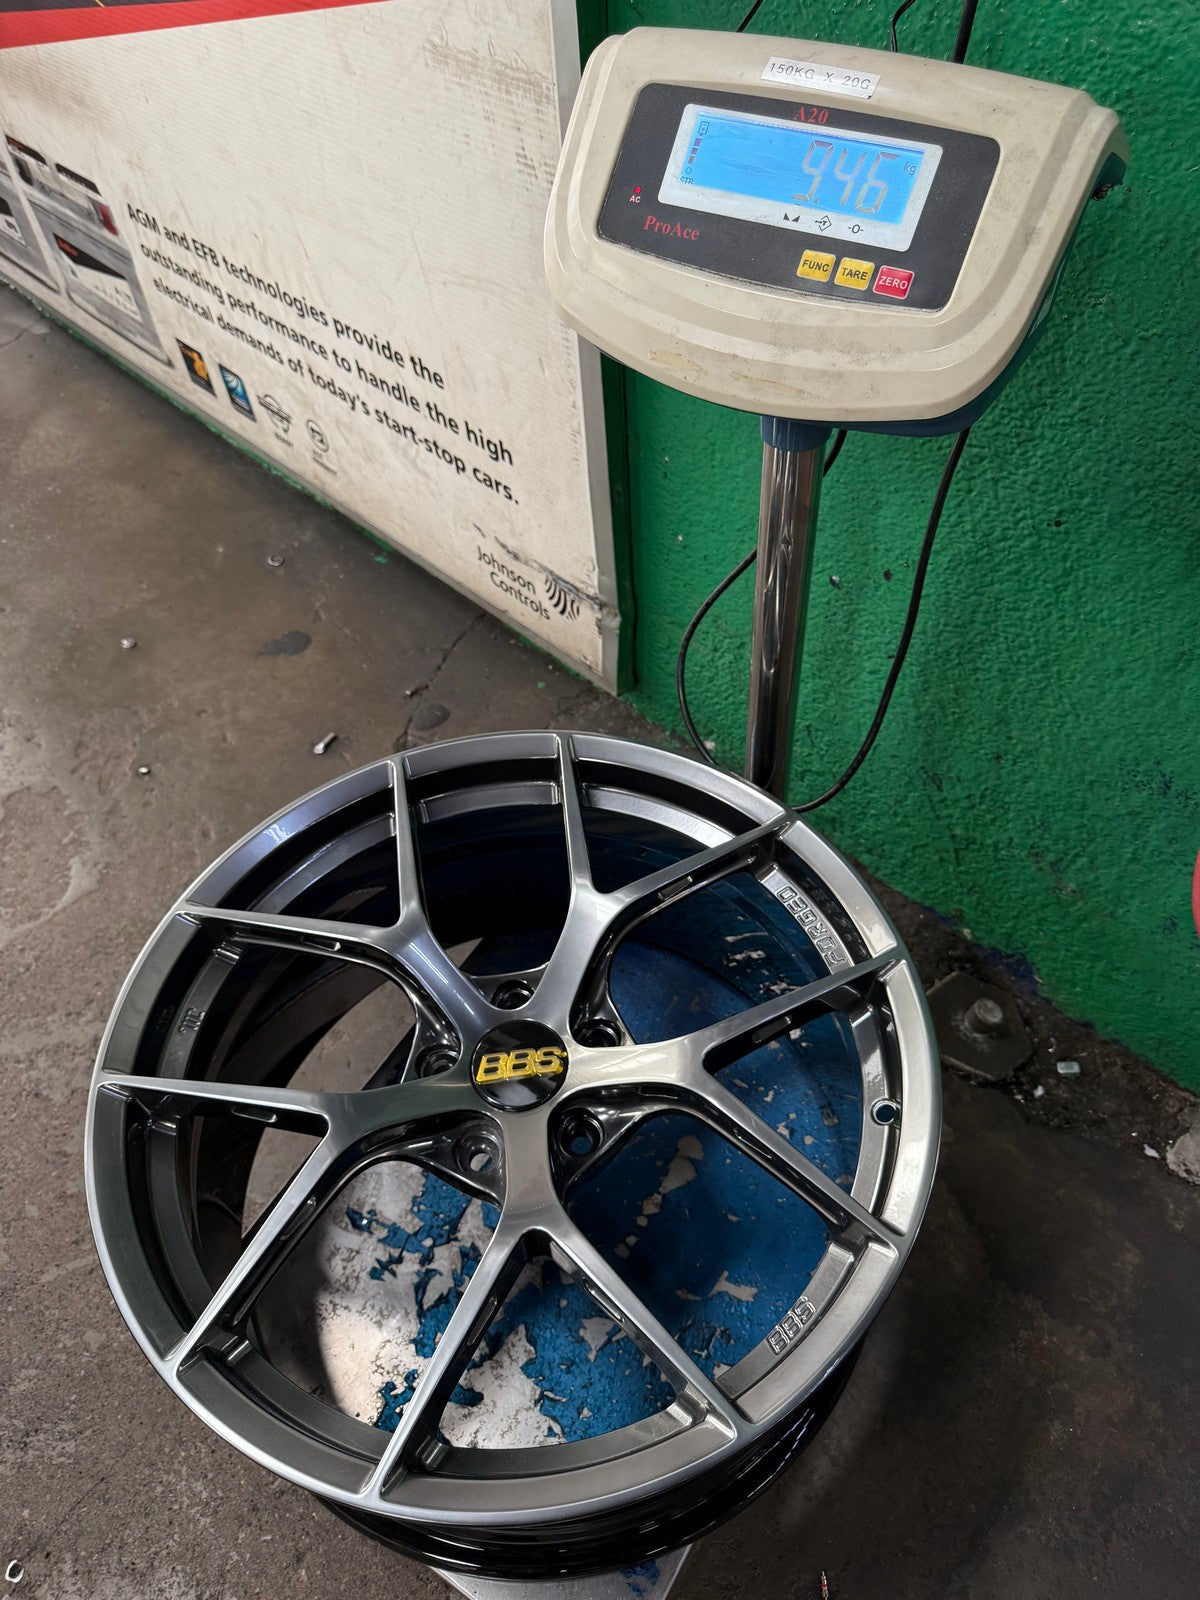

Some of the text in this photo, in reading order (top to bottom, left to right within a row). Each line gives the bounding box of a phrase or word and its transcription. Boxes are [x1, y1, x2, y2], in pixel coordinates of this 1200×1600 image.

[770, 62, 871, 90] 150KG X 20G
[794, 106, 829, 125] A20
[903, 161, 917, 176] kg
[629, 195, 641, 203] AC
[643, 215, 700, 240] ProAce
[802, 260, 830, 273] FUNC
[841, 267, 869, 281] TARE
[878, 276, 908, 290] ZERO
[127, 203, 445, 390] AGM and EFB technologies provide the
[141, 244, 225, 306] outstanding
[226, 292, 329, 361] performance
[332, 349, 352, 373] to
[355, 359, 421, 413] handle
[426, 401, 460, 435] the
[465, 420, 514, 467] high
[153, 277, 215, 324] electrical
[216, 313, 285, 366] demands
[288, 358, 305, 378] of
[308, 367, 370, 416] today's
[375, 409, 467, 475] start-stop
[472, 467, 520, 505] cars.
[477, 546, 537, 596] Johnson
[490, 571, 550, 621] Controls
[776, 884, 846, 967] FORGED
[476, 1045, 567, 1085] BBS
[766, 1296, 816, 1355] BBS
